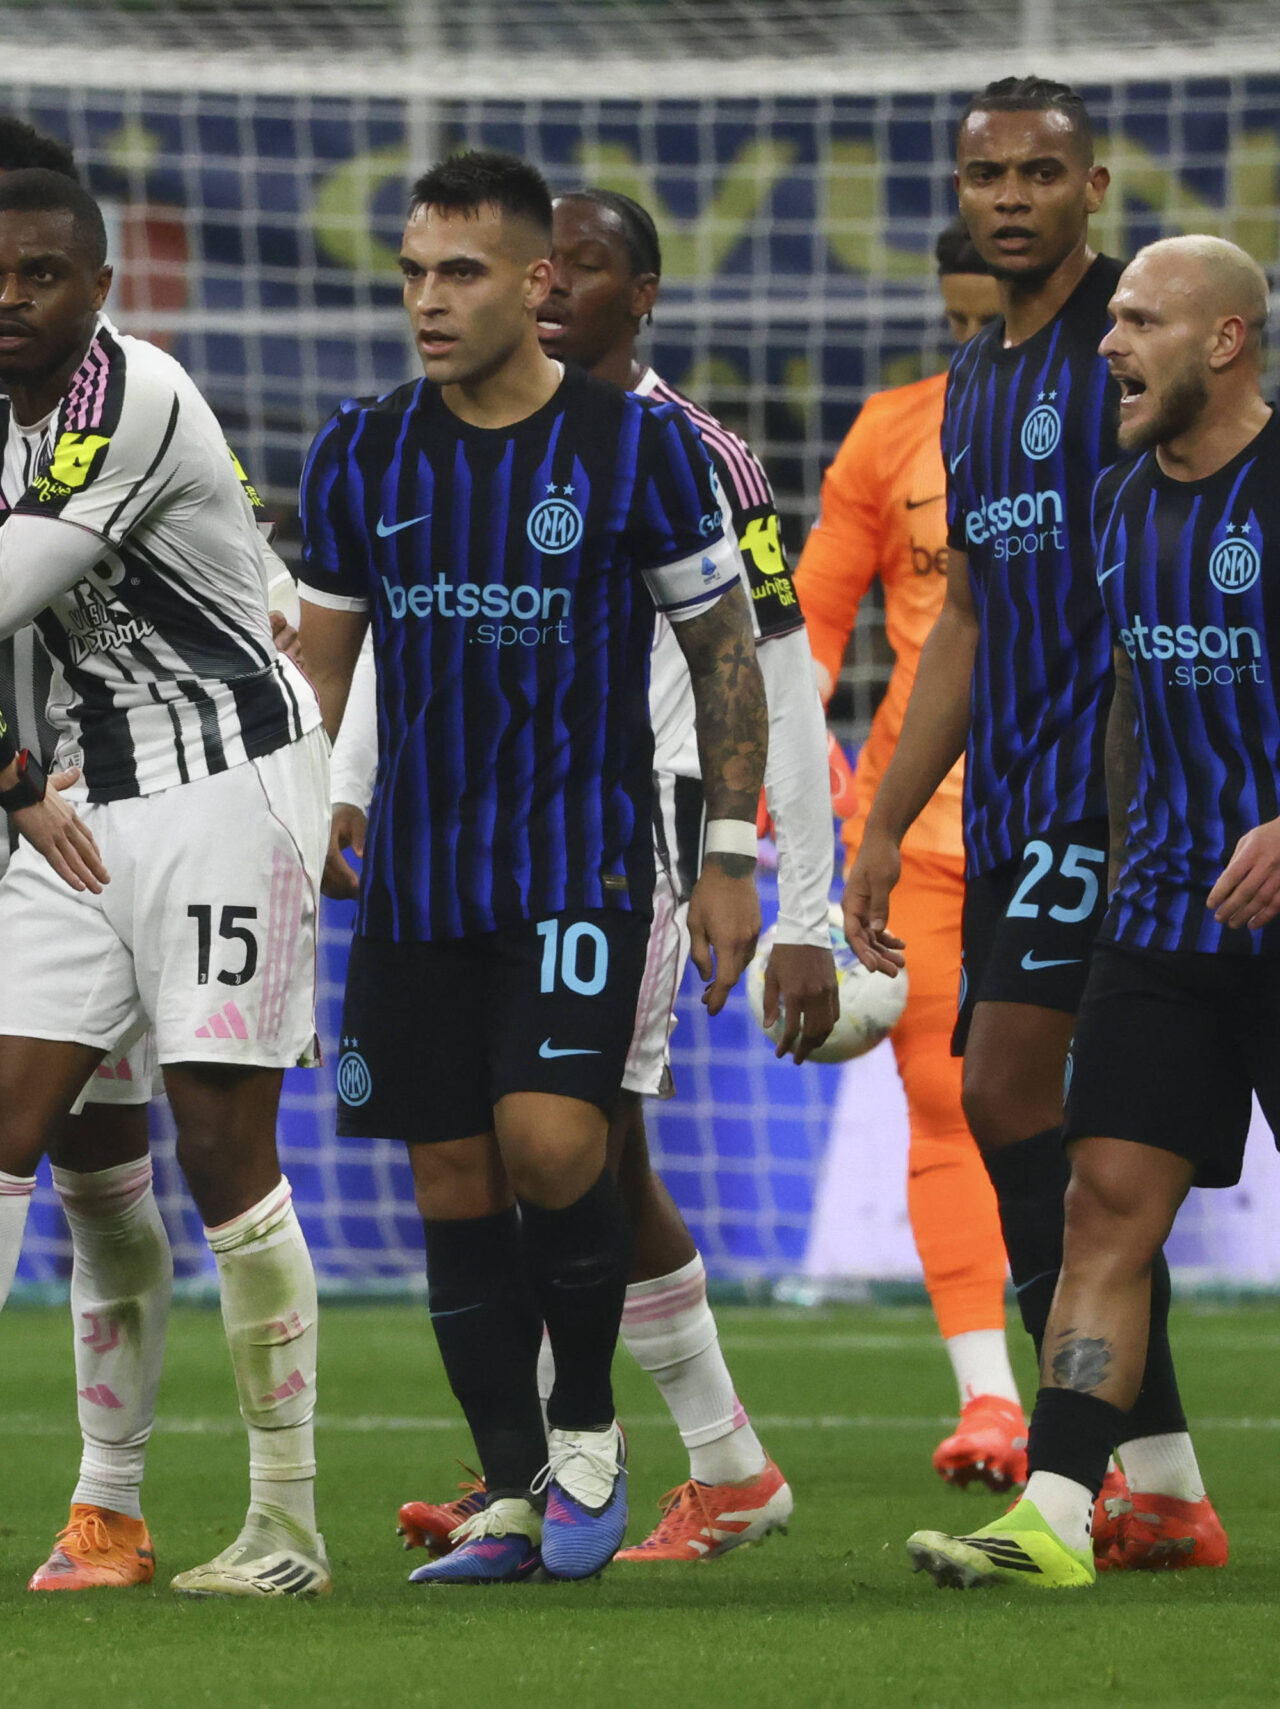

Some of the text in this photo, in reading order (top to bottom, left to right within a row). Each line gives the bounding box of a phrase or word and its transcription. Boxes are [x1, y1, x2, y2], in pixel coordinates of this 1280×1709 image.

[382, 572, 572, 620] betsson
[751, 577, 791, 600] white
[1006, 840, 1105, 923] 25
[187, 905, 257, 986] 15
[536, 919, 609, 996] 10
